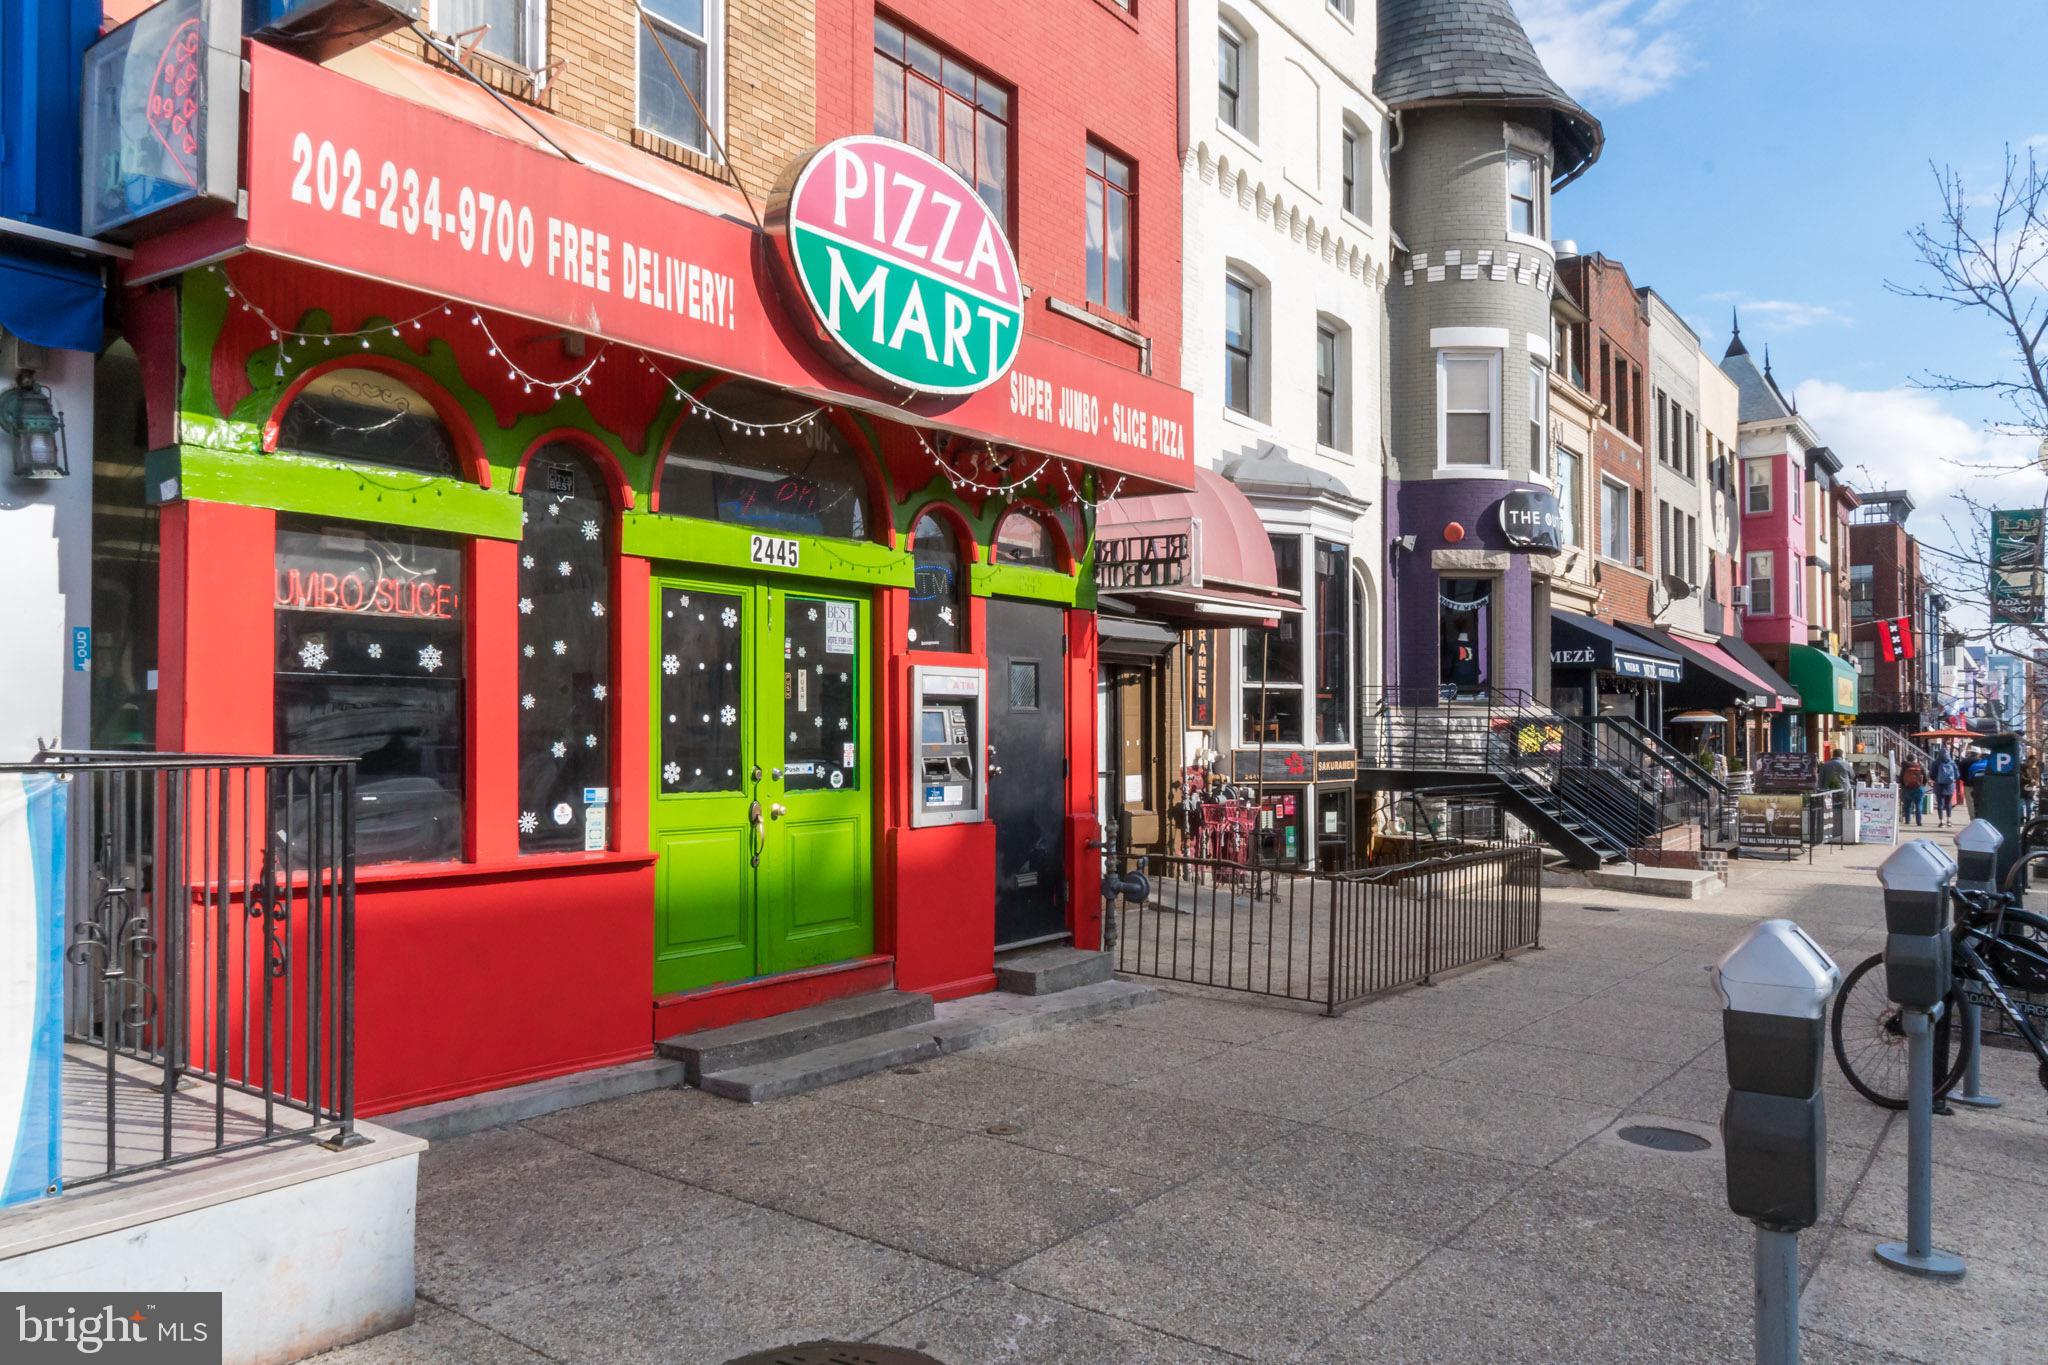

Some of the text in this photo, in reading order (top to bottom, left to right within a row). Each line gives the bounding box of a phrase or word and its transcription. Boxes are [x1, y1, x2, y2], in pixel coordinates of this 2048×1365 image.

[833, 146, 1007, 294] PIZZA
[291, 132, 735, 330] 202-234-9700 FREE DELIVERY!
[826, 246, 1010, 379] MART
[1010, 370, 1185, 460] SUPER JUMBO SLICE PIZZA
[550, 480, 572, 491] BEST
[1509, 510, 1541, 525] THE
[753, 537, 798, 566] 2445
[914, 572, 948, 594] TM
[275, 568, 452, 619] UMBO SLICE
[827, 606, 853, 619] BEST
[1550, 646, 1595, 664] MEZÈ
[952, 681, 975, 690] ATM
[1318, 760, 1355, 771] SAKURAMEN
[1996, 753, 2011, 771] P
